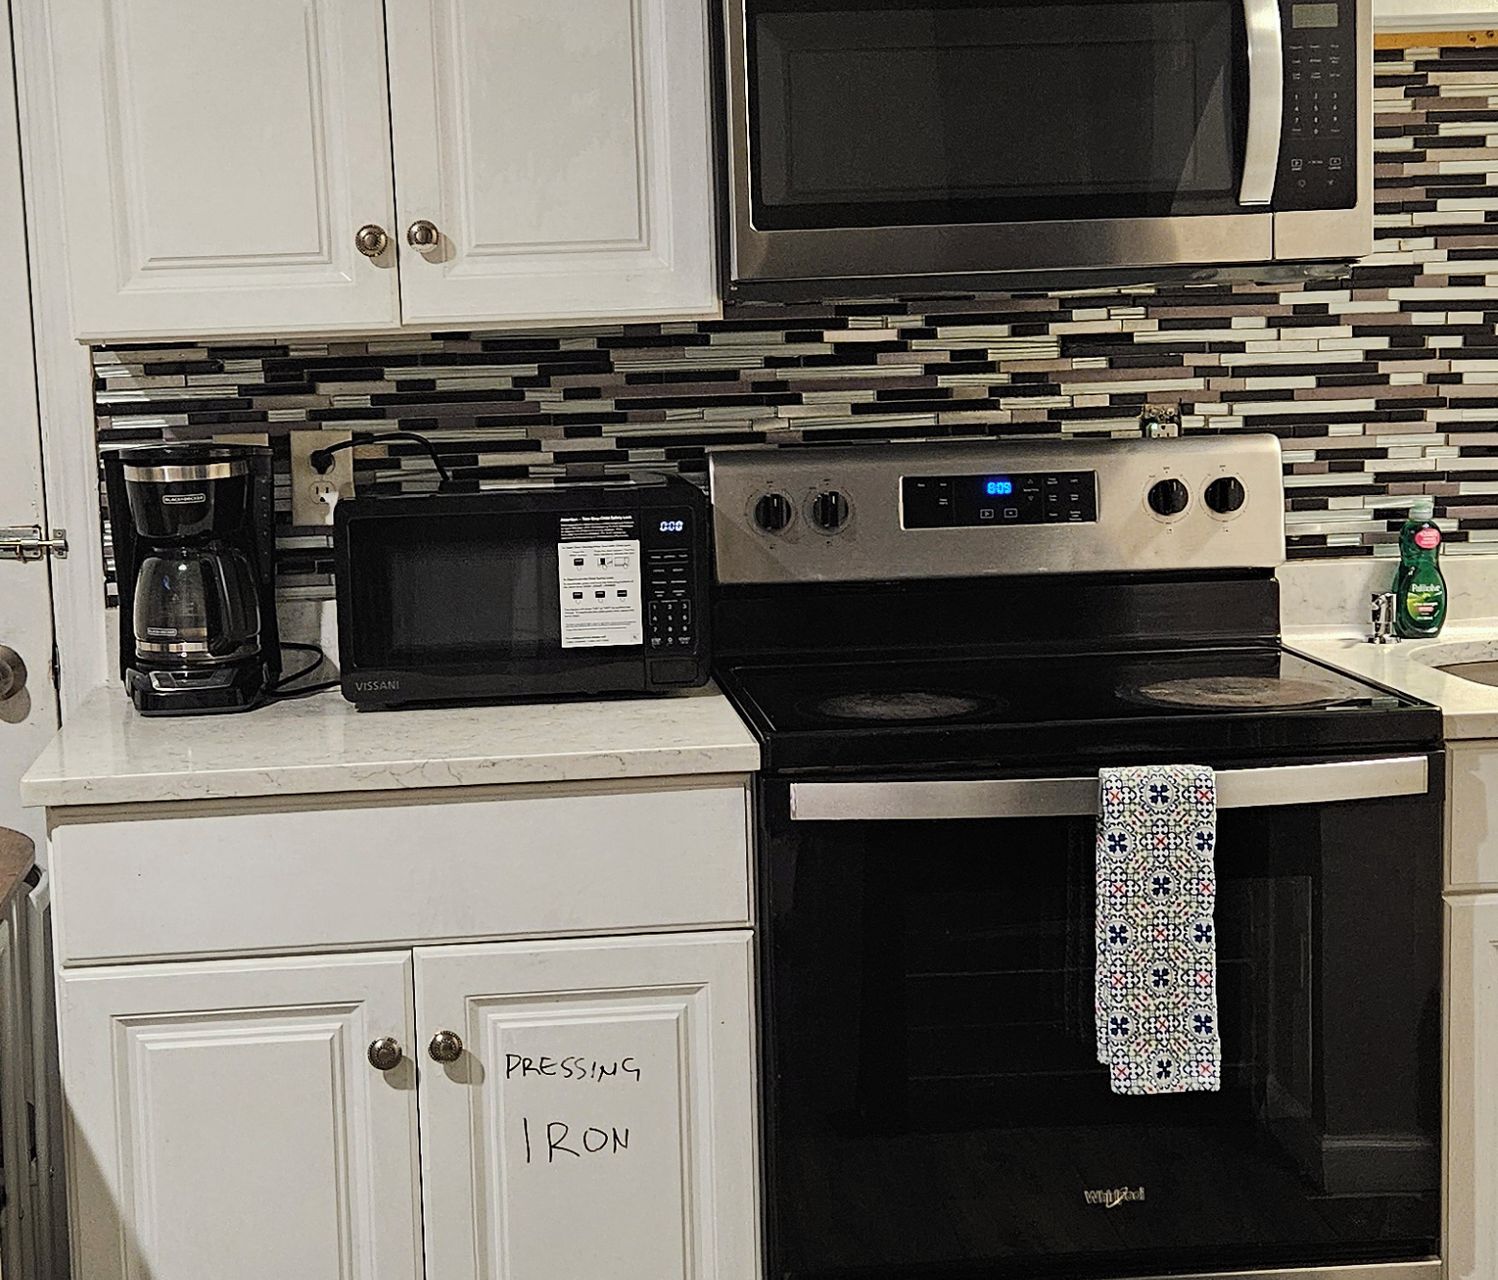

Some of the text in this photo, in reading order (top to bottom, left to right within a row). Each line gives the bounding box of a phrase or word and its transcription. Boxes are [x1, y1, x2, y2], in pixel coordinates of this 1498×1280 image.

[987, 481, 1011, 495] 8:09
[355, 681, 400, 691] VISSANI
[505, 1054, 641, 1082] PRESSING
[523, 1117, 629, 1163] IRON
